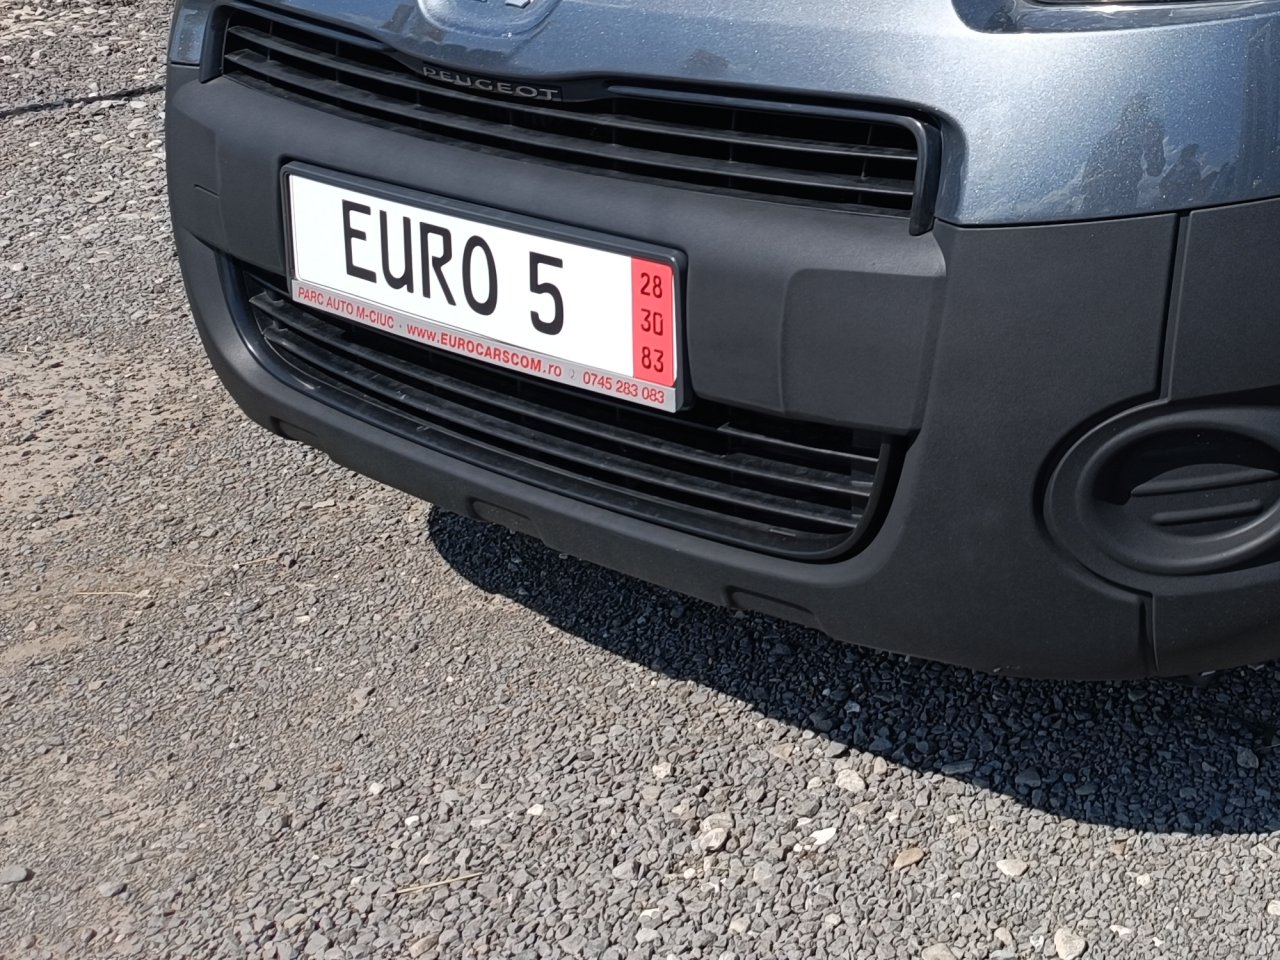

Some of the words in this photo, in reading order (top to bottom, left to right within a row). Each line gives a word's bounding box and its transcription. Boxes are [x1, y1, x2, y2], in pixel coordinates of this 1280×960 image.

[422, 66, 559, 101] PEUGEOT
[341, 198, 499, 316] EURO
[528, 250, 565, 336] 5
[640, 272, 663, 299] 28
[640, 308, 664, 336] 30
[297, 286, 325, 306] PARC
[326, 296, 354, 315] AUTO
[355, 306, 395, 329] M-CIUC
[582, 371, 613, 391] 0745
[615, 380, 639, 398] 283
[641, 387, 665, 405] 083
[641, 346, 664, 373] 83
